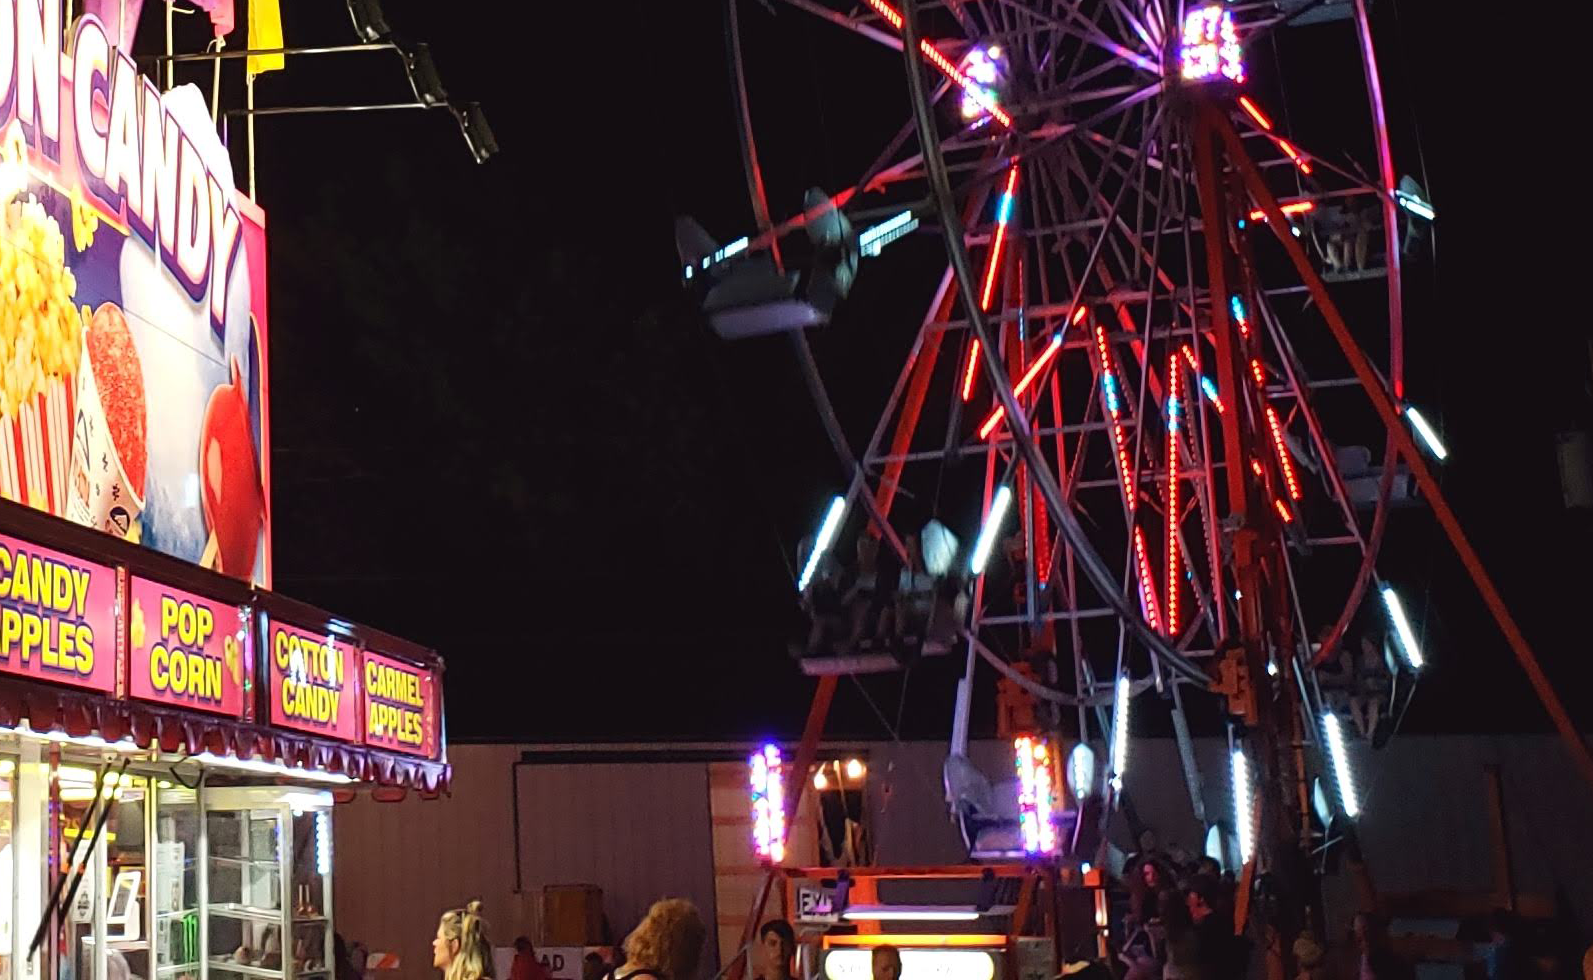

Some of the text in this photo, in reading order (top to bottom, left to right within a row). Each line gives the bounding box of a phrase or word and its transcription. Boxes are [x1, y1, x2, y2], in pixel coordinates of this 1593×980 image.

[74, 14, 241, 324] CANDY
[160, 595, 214, 649] POP
[149, 644, 223, 702] CORN
[274, 629, 345, 685] COTTON
[364, 660, 425, 708] CARMEL
[281, 676, 341, 725] CANDY
[367, 700, 424, 746] APPLES
